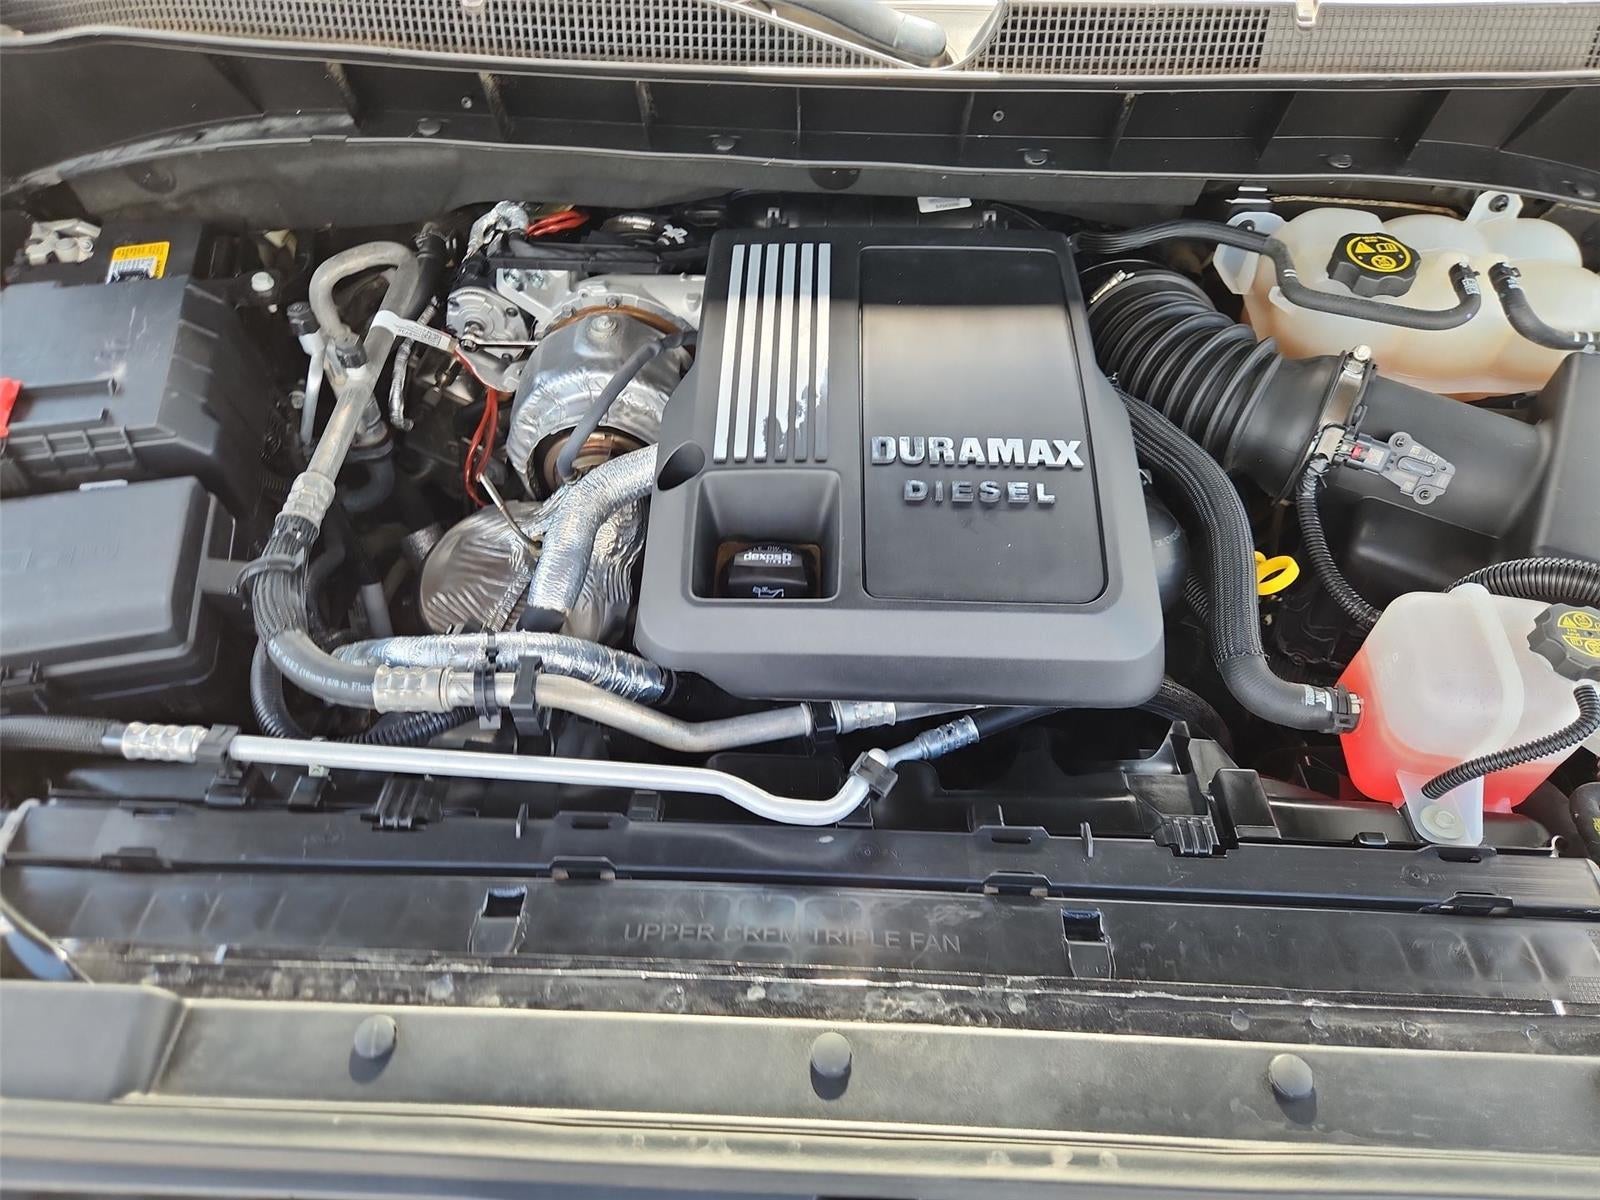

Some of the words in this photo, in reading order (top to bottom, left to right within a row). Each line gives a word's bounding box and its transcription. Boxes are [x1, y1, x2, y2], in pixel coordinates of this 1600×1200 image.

[871, 436, 1085, 468] DURAMAX
[903, 479, 1056, 504] DIESEL
[624, 922, 715, 942] UPPER
[808, 928, 901, 949] TRIPLE
[910, 931, 961, 954] FAN
